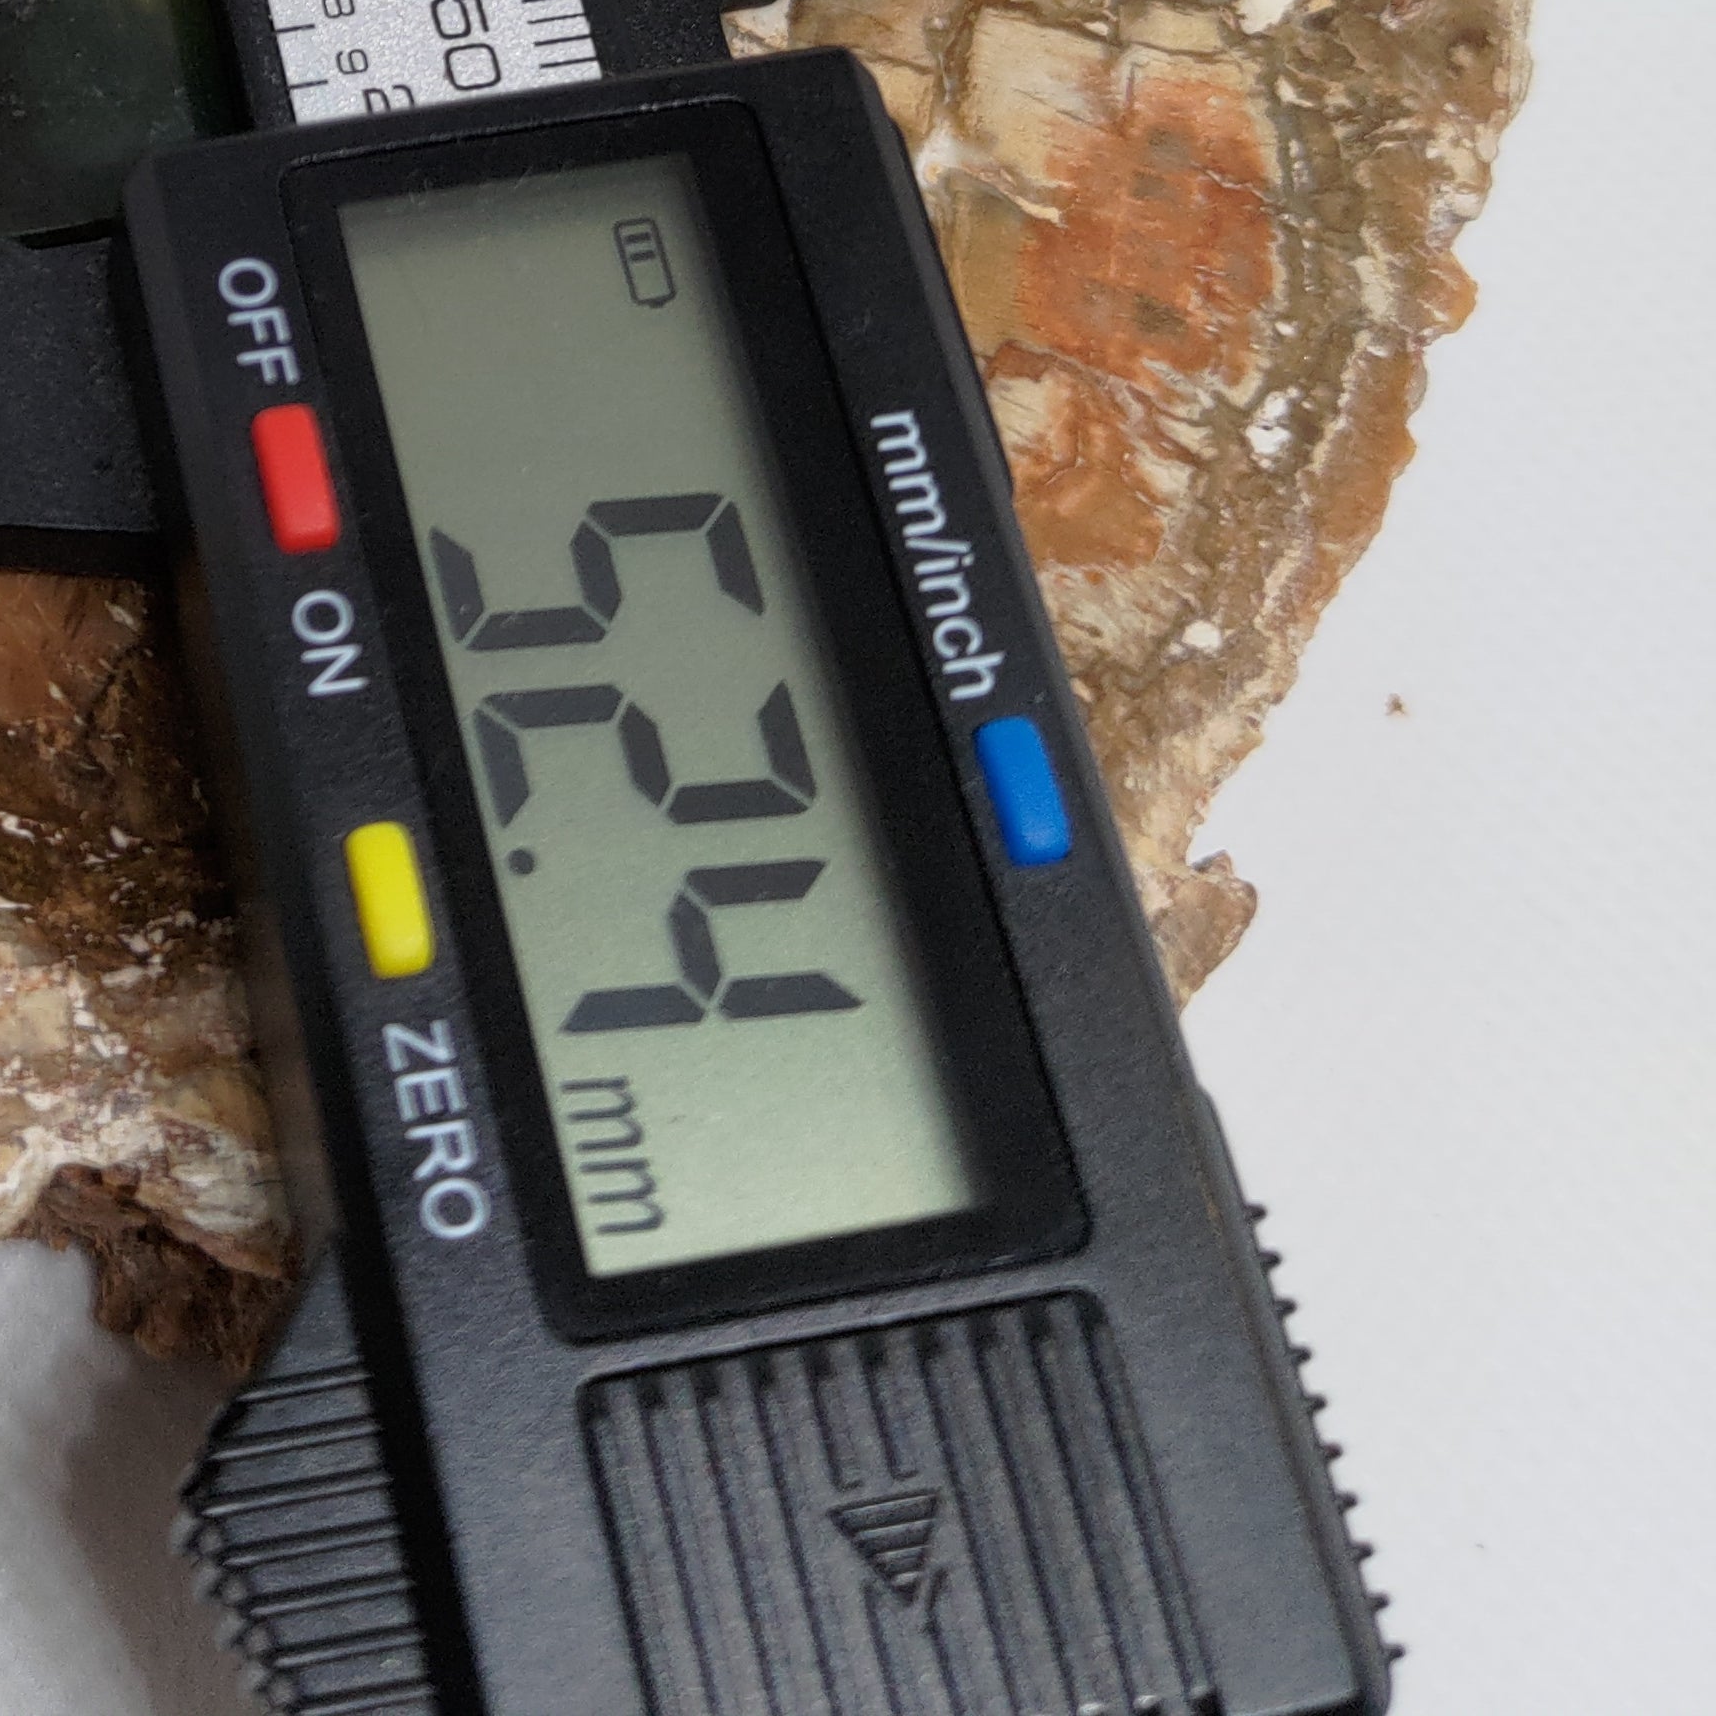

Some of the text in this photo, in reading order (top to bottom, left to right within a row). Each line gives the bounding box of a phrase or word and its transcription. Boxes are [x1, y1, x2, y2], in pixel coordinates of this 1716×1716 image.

[336, 49, 369, 75] 9
[216, 257, 301, 387] OFF
[290, 589, 368, 696] ON
[869, 409, 1007, 703] mm/inch
[428, 491, 864, 1236] 52.4 mm
[380, 1020, 492, 1240] ZERO
